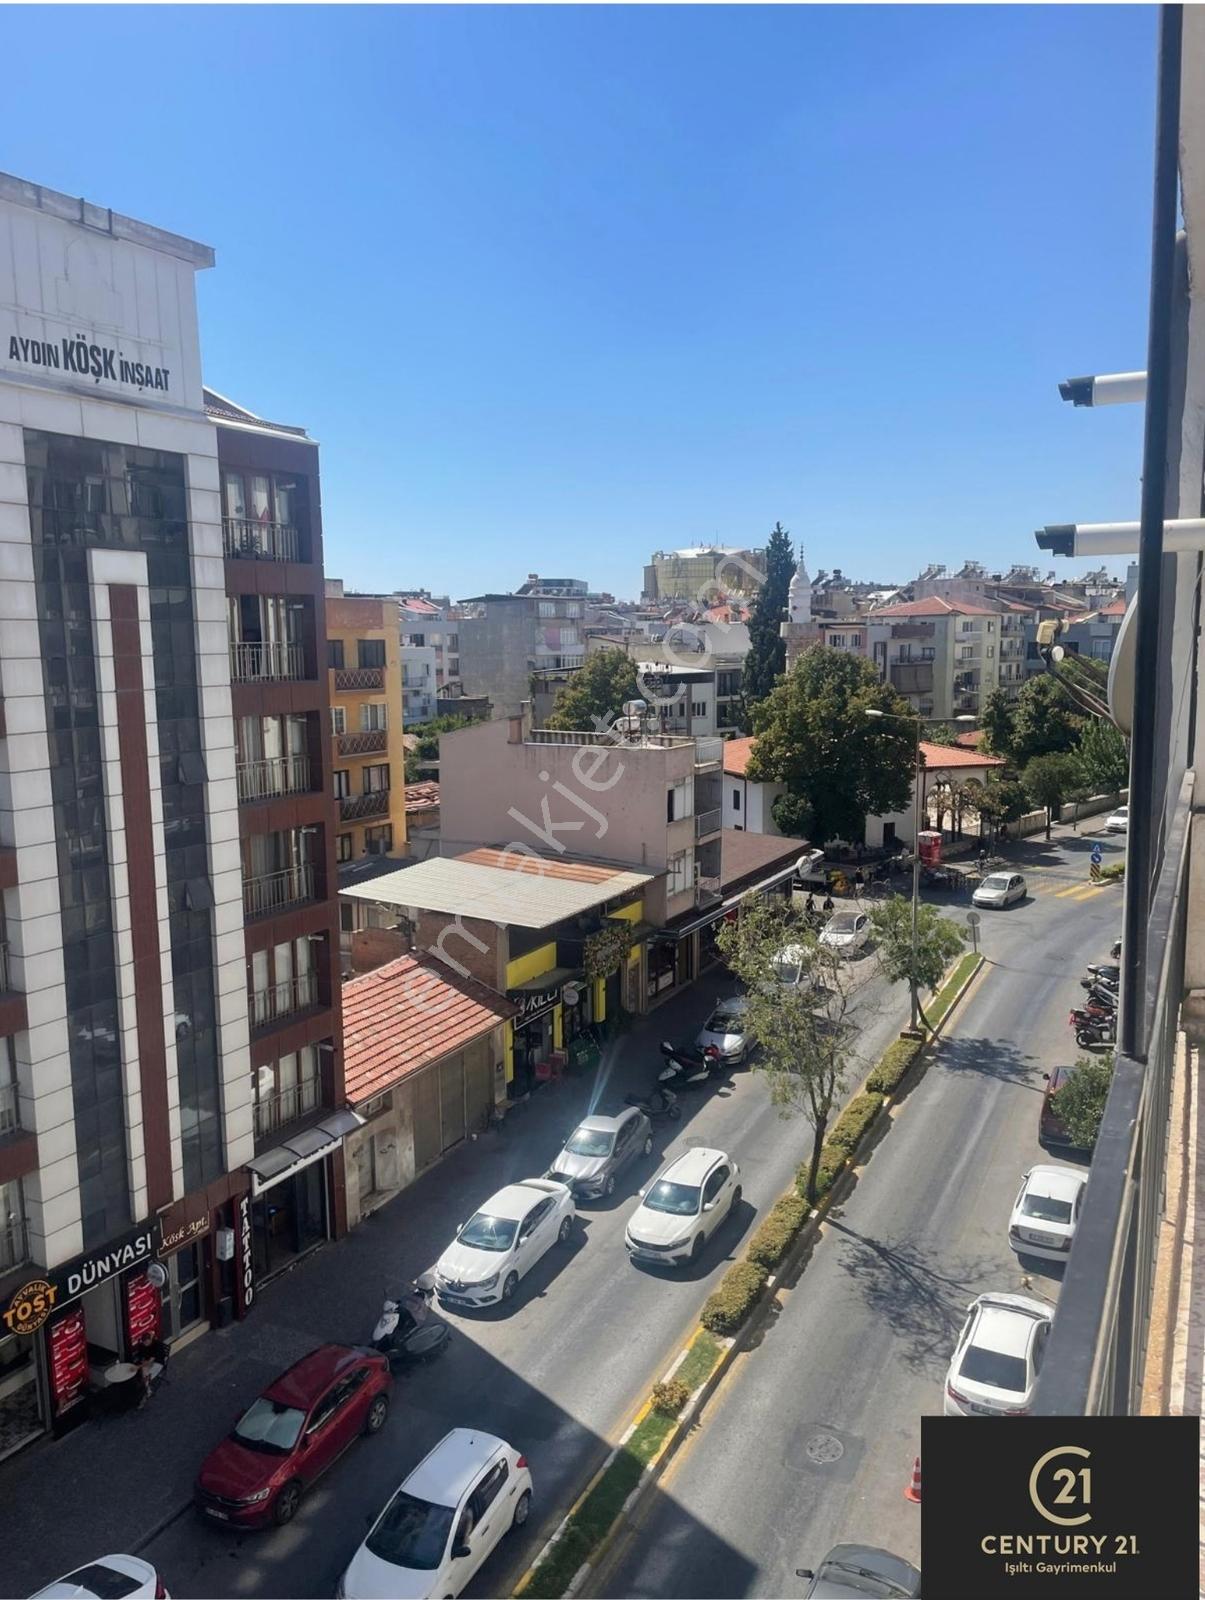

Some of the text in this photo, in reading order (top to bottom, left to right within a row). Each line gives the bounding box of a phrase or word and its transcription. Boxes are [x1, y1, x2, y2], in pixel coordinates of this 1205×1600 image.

[9, 333, 170, 391] AYDIN KÖŞK İNŞAAT
[67, 1232, 152, 1295] DÜNYASI
[240, 1196, 253, 1306] TATTOO
[2, 1285, 58, 1328] TOST
